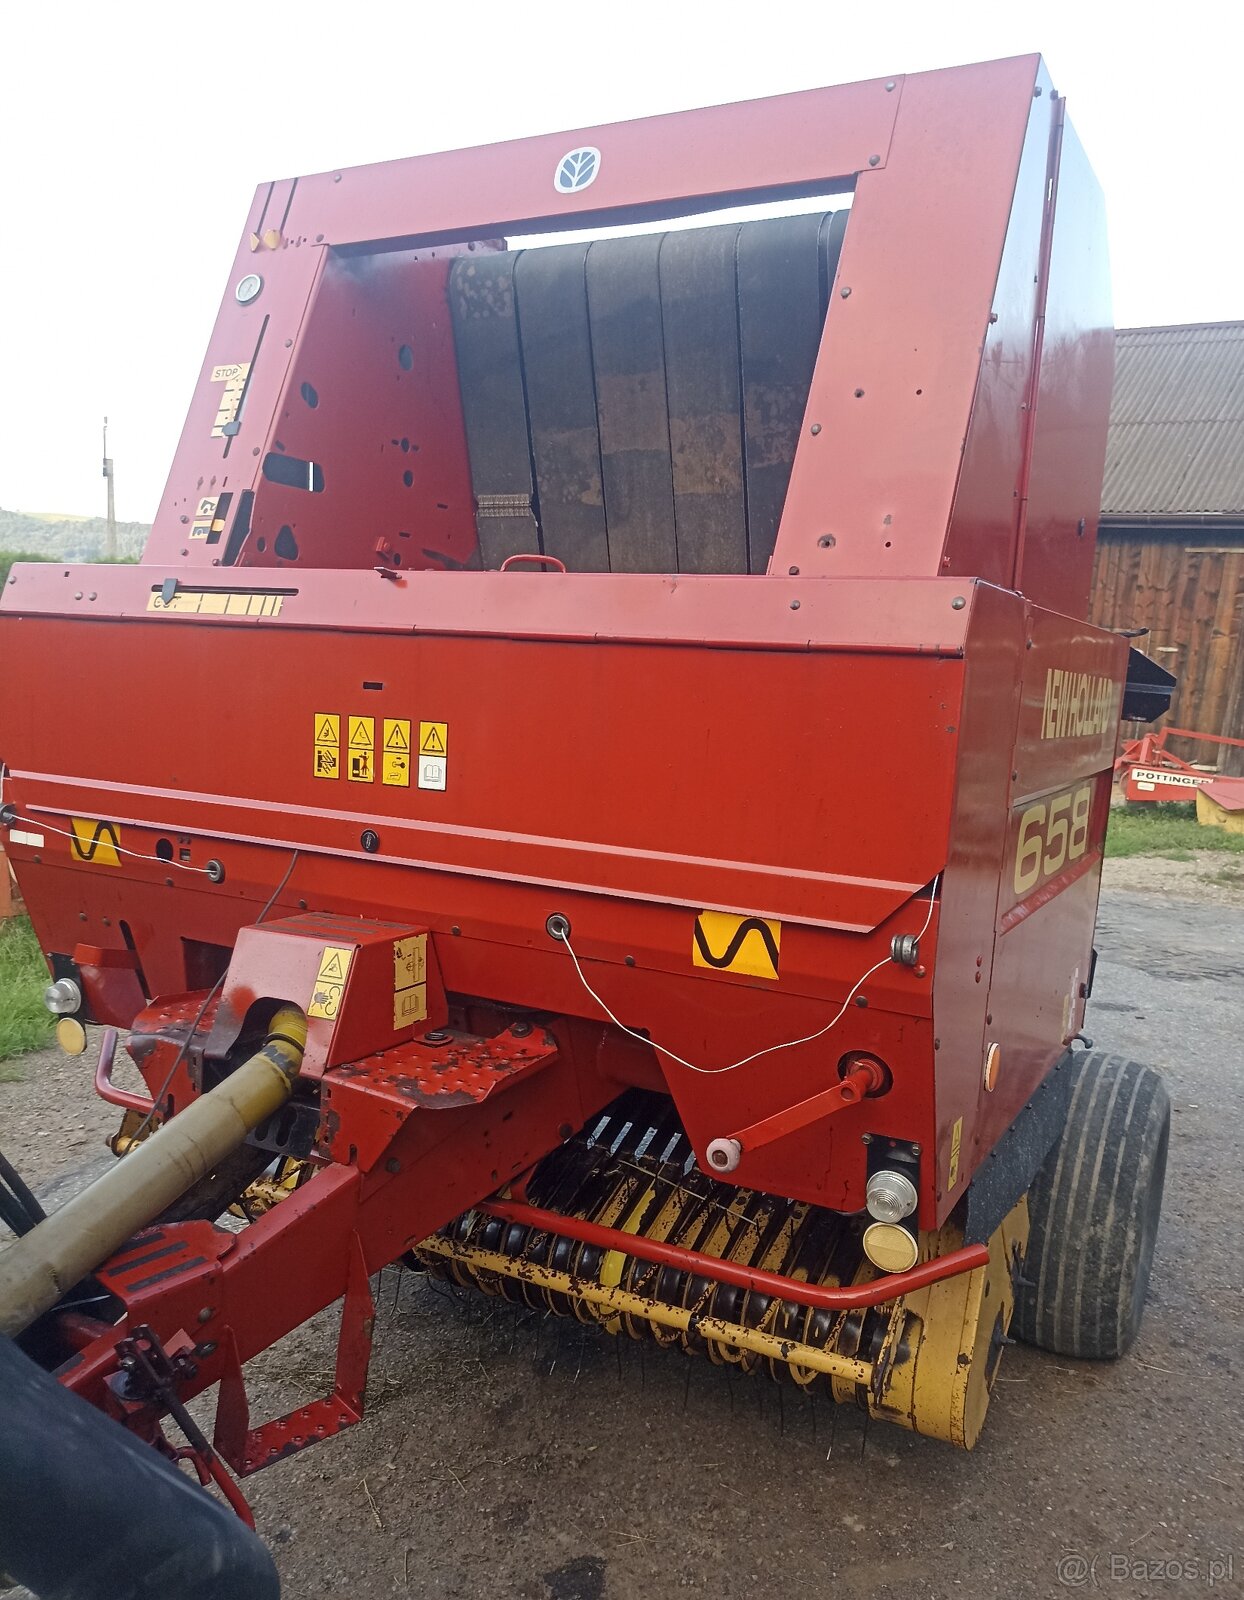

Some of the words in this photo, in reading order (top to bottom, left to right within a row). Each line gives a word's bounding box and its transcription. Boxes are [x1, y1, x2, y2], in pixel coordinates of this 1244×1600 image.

[214, 368, 238, 378] STOP
[153, 595, 182, 609] CT
[1041, 668, 1072, 740] NEW
[1067, 673, 1113, 738] HOLLAND
[1013, 786, 1091, 895] 658
